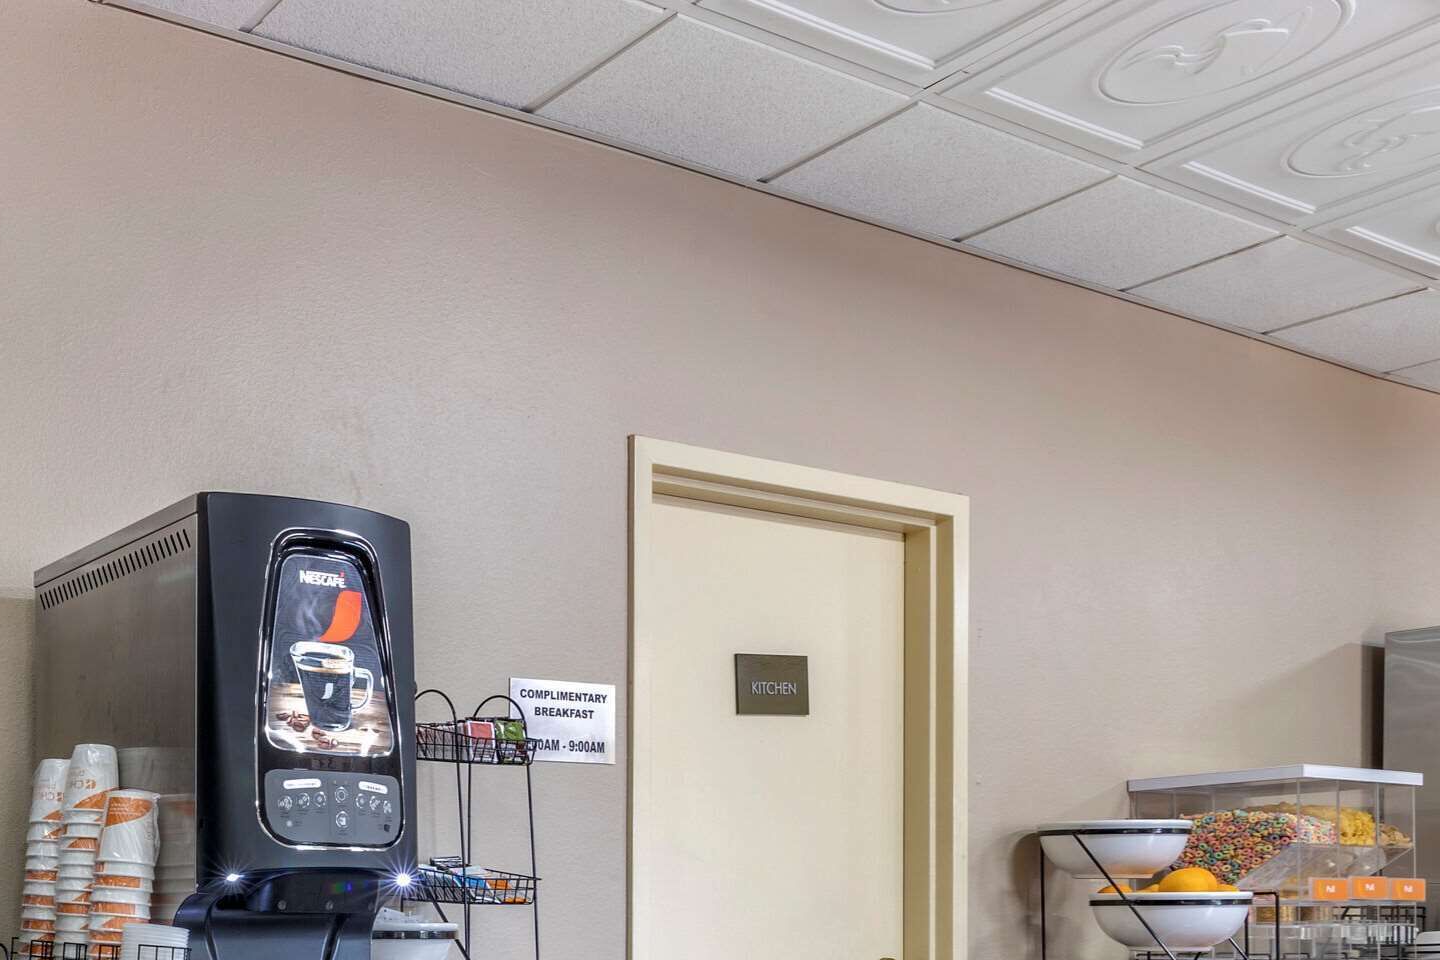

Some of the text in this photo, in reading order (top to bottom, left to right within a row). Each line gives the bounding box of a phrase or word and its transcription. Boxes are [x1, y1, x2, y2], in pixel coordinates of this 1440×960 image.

[751, 681, 797, 695] KITCHEN
[520, 688, 607, 704] COMPLIMENTARY
[534, 706, 594, 719] BREAKFAST
[568, 740, 605, 753] 9:00AM
